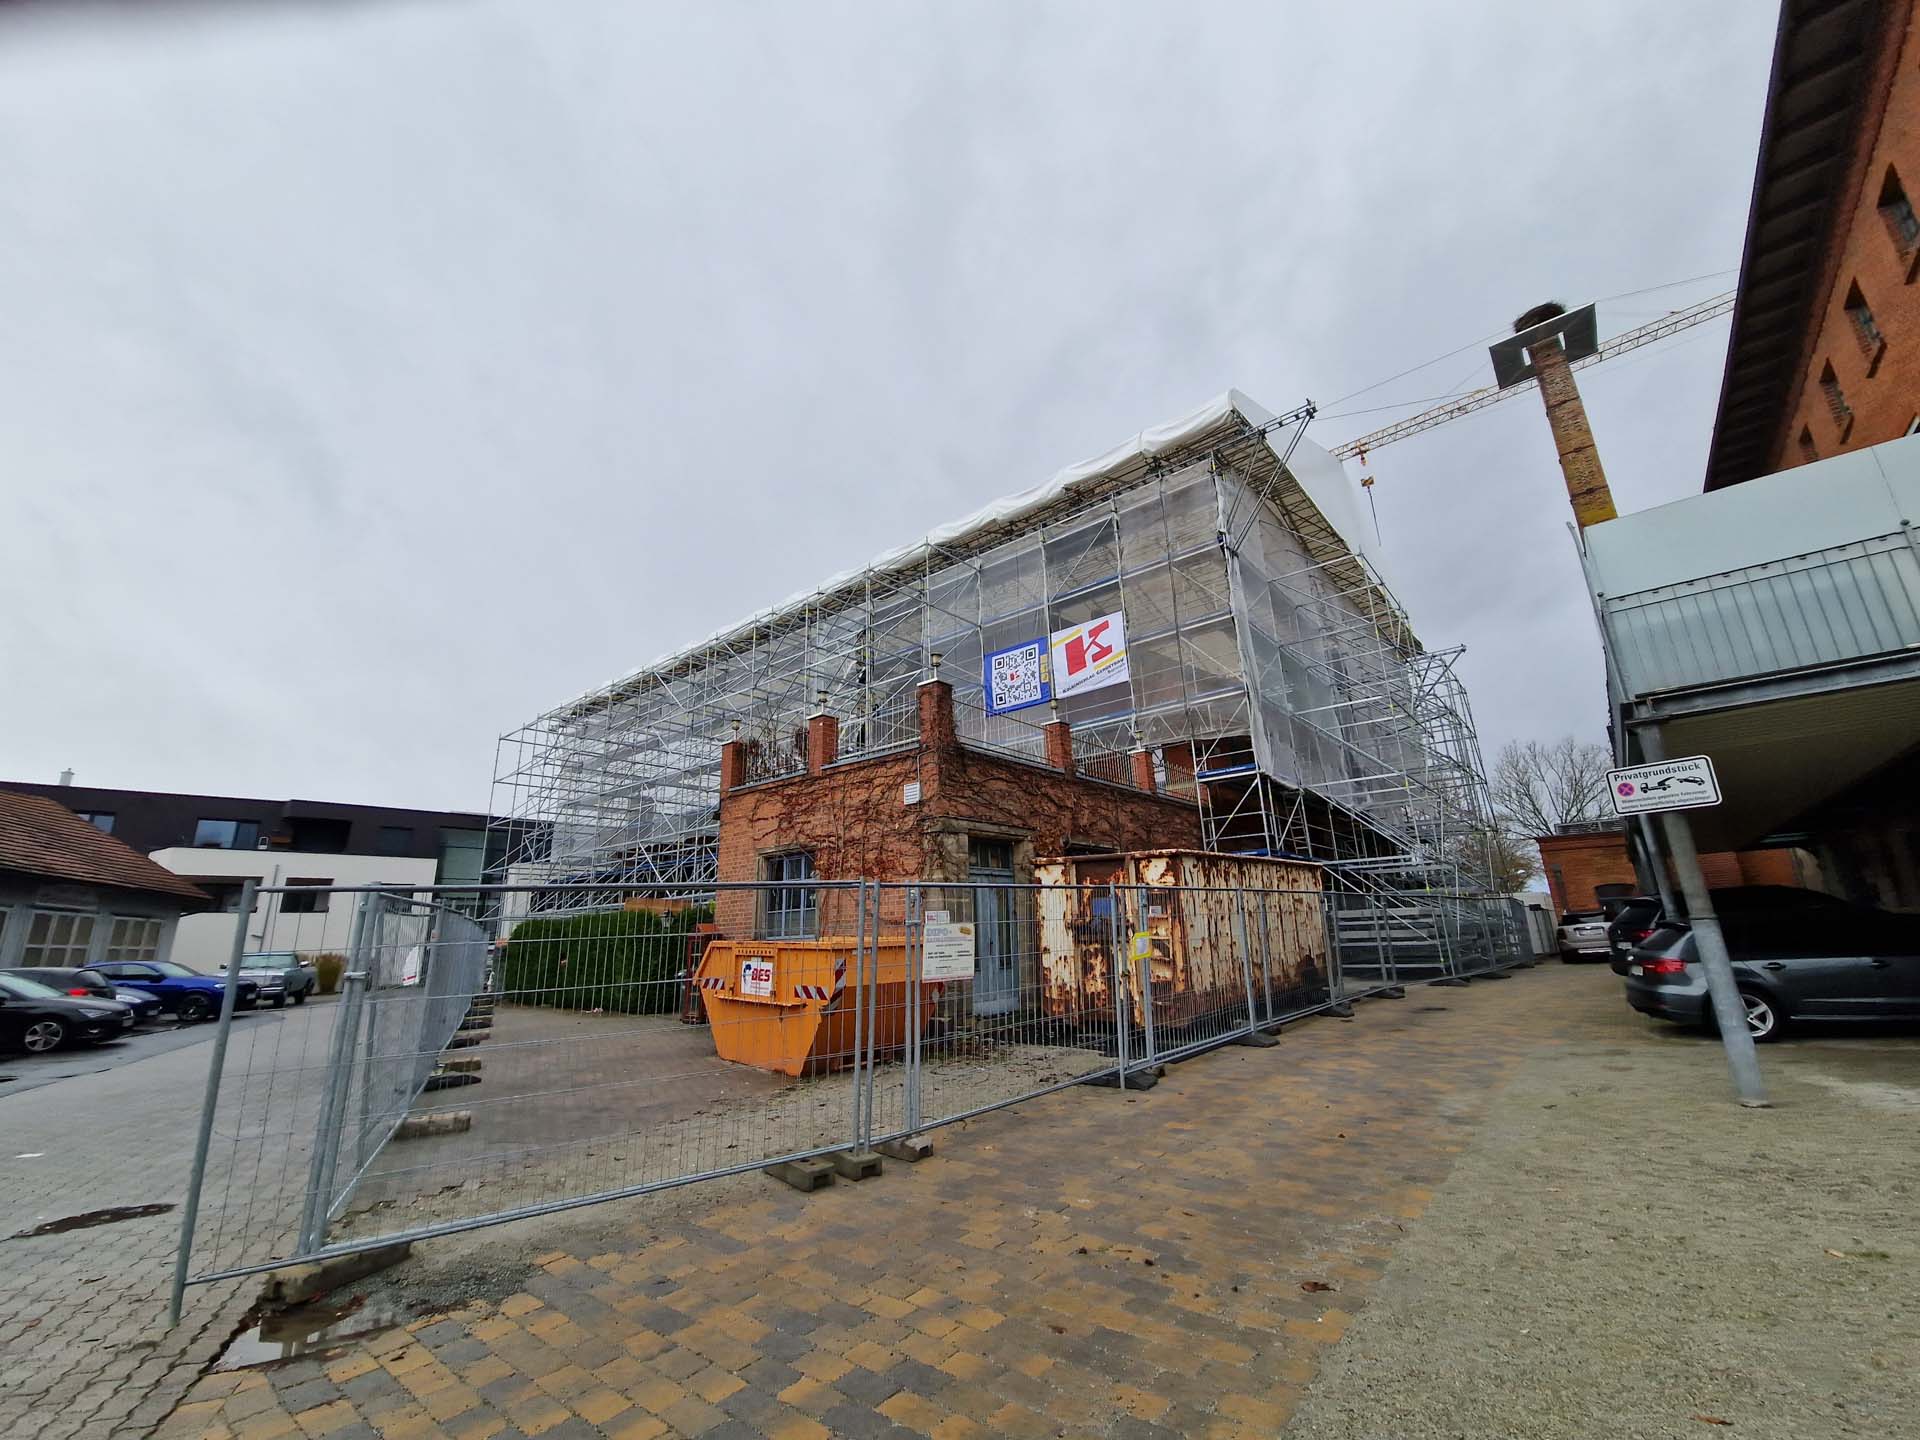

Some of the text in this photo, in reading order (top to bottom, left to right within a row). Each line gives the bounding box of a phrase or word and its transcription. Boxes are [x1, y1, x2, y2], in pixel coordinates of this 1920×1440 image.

[1065, 620, 1113, 676] K
[1613, 762, 1701, 782] Privatgrundstück
[751, 967, 771, 982] BES
